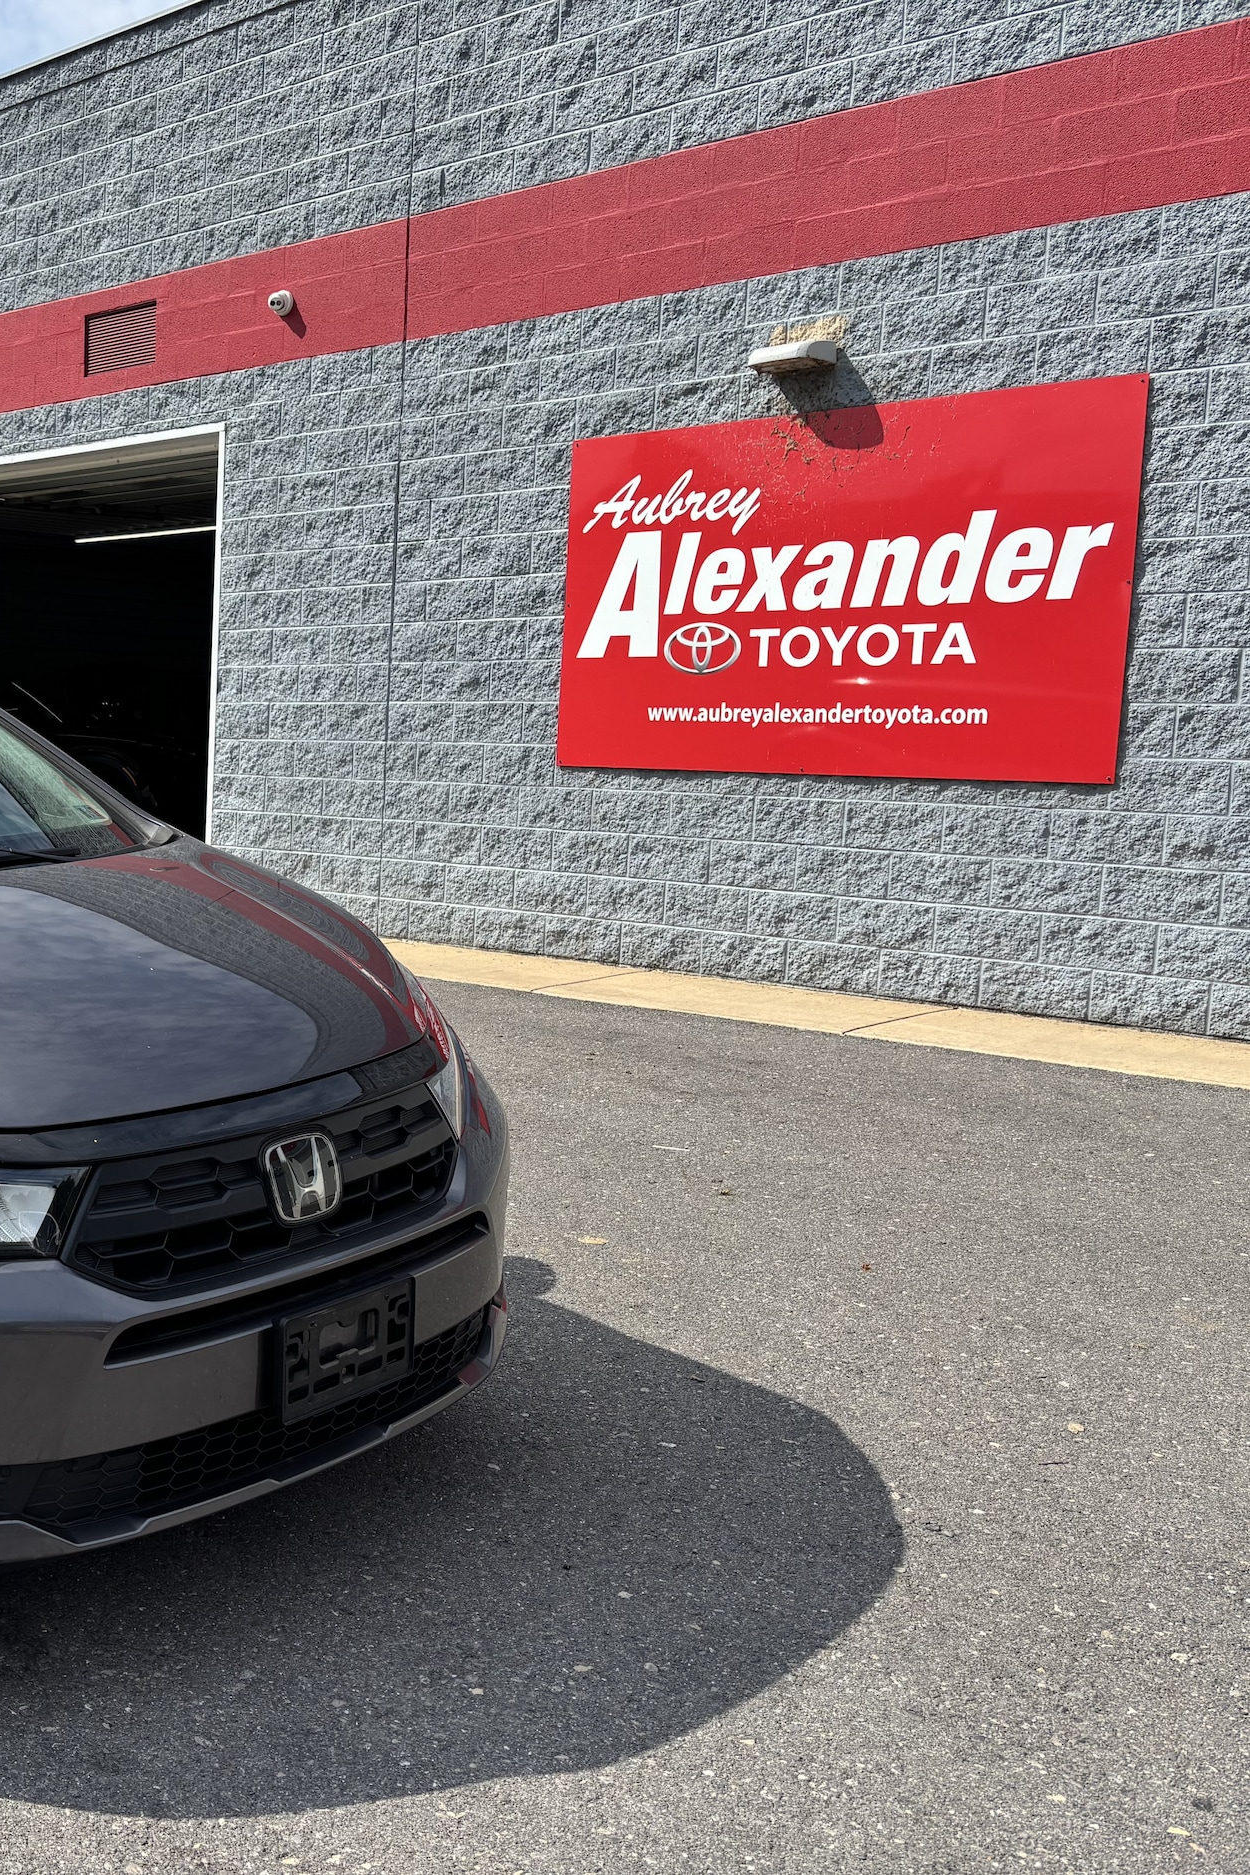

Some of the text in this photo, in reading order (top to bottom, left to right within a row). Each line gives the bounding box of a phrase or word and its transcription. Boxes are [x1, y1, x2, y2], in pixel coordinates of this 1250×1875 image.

[583, 468, 761, 536] Aubrey
[576, 509, 1115, 659] Alexander
[749, 622, 976, 668] TOYOTA
[647, 702, 989, 729] www.aubreyalexandertoyota.com
